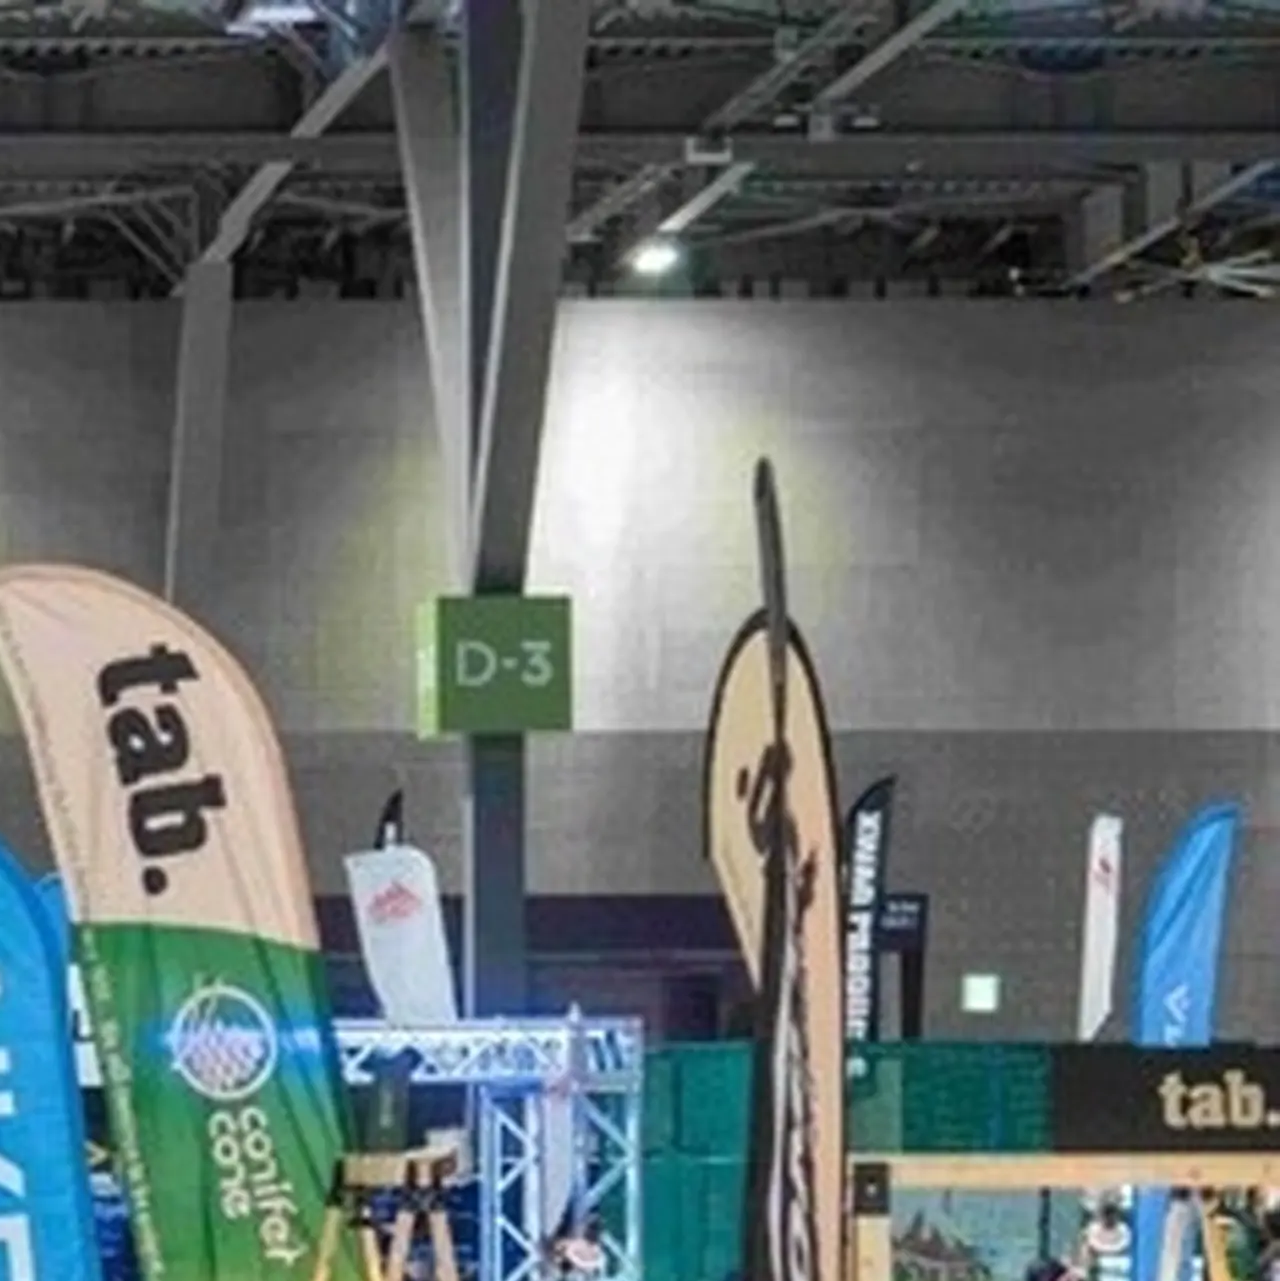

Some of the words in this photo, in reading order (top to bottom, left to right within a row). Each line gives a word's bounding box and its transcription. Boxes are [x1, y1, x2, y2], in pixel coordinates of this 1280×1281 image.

[456, 640, 554, 686] D-3
[97, 643, 226, 896] tab.
[1157, 1068, 1280, 1131] tab.
